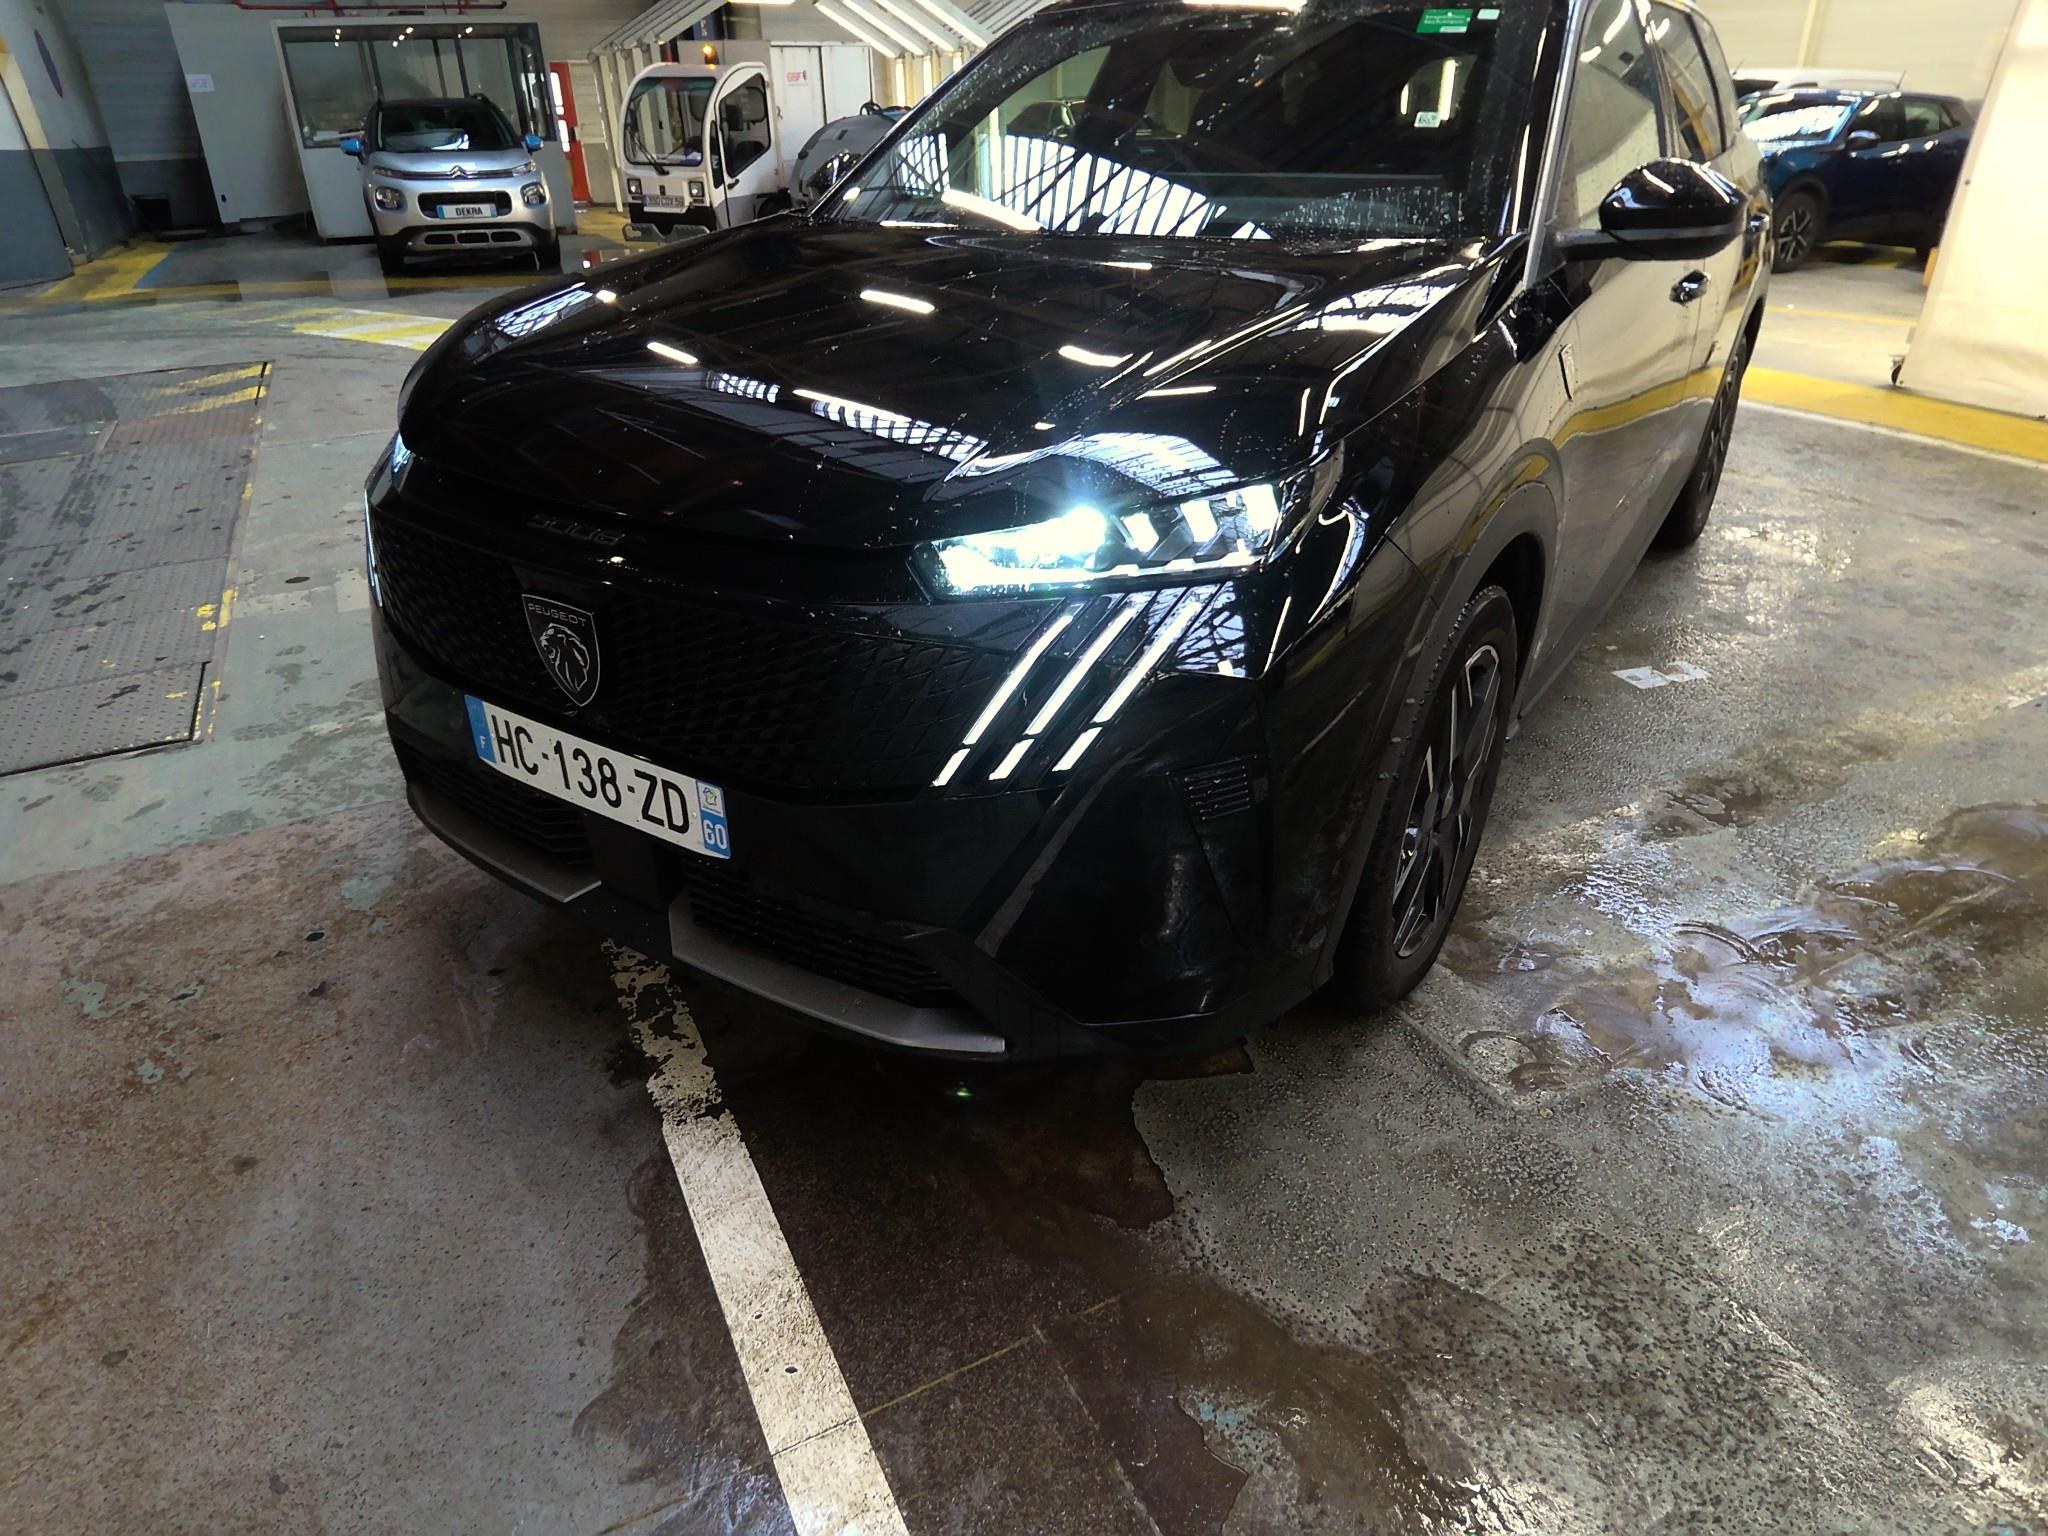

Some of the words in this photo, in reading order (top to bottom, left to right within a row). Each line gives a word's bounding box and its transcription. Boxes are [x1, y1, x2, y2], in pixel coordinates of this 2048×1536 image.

[455, 206, 484, 217] DEKRA
[527, 602, 588, 628] PEUGEOT
[480, 735, 486, 749] F
[491, 714, 690, 834] HC-138-ZD
[703, 819, 728, 850] 60
